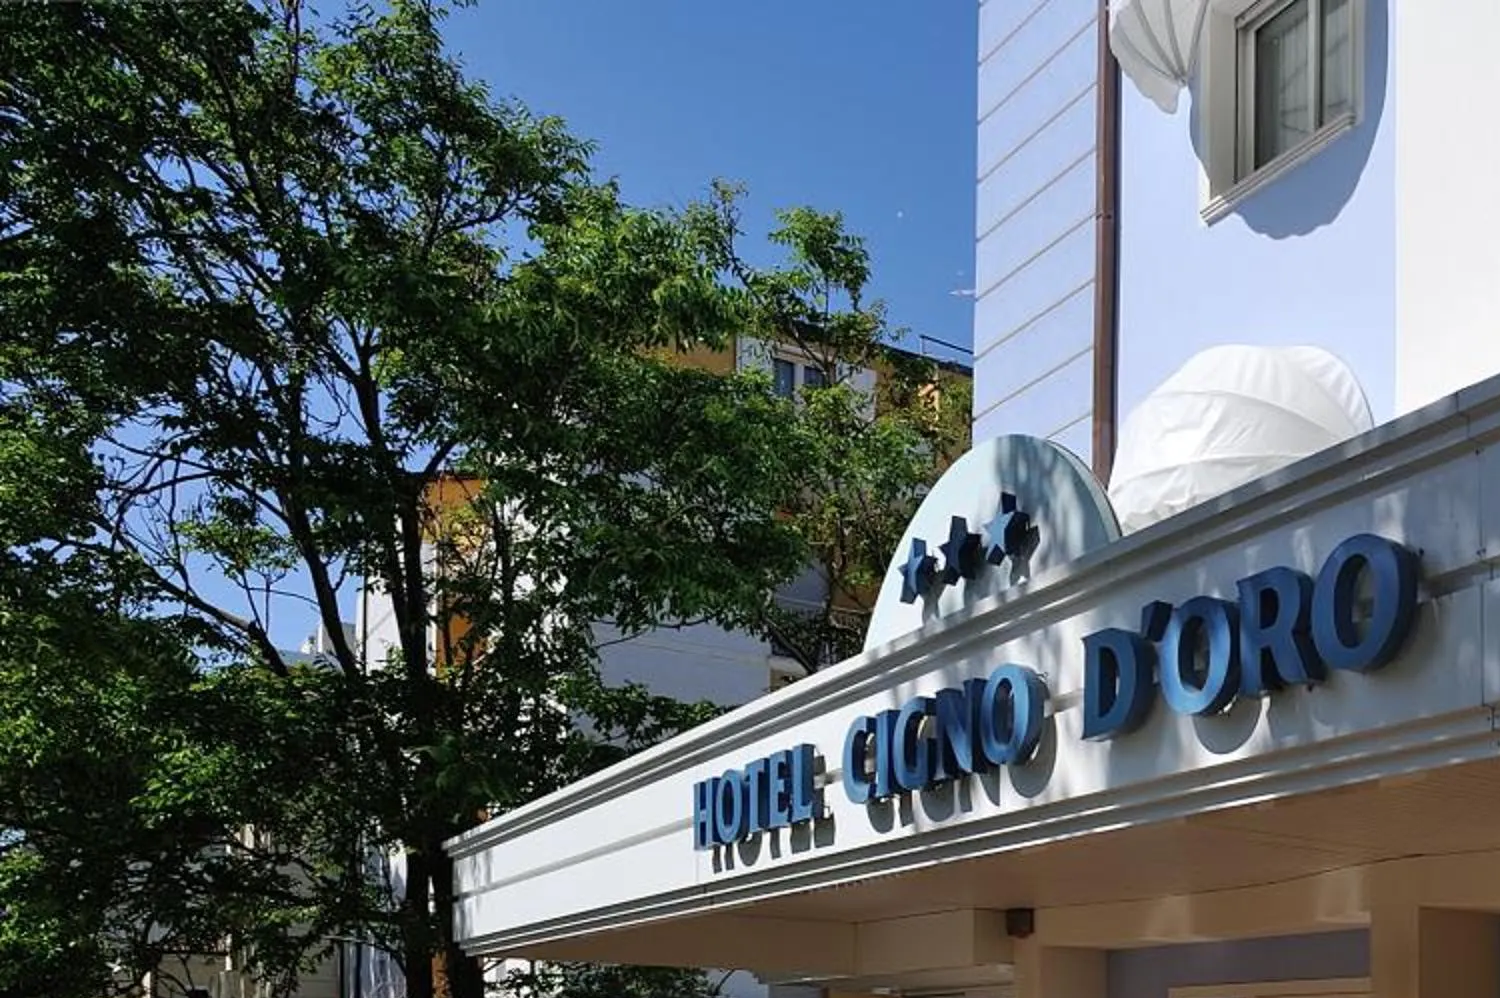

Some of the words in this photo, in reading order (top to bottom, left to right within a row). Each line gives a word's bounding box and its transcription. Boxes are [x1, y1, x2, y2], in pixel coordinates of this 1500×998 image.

[694, 743, 816, 851] HOTEL
[842, 663, 1046, 804] CIGNO
[1081, 533, 1419, 742] D'ORO
